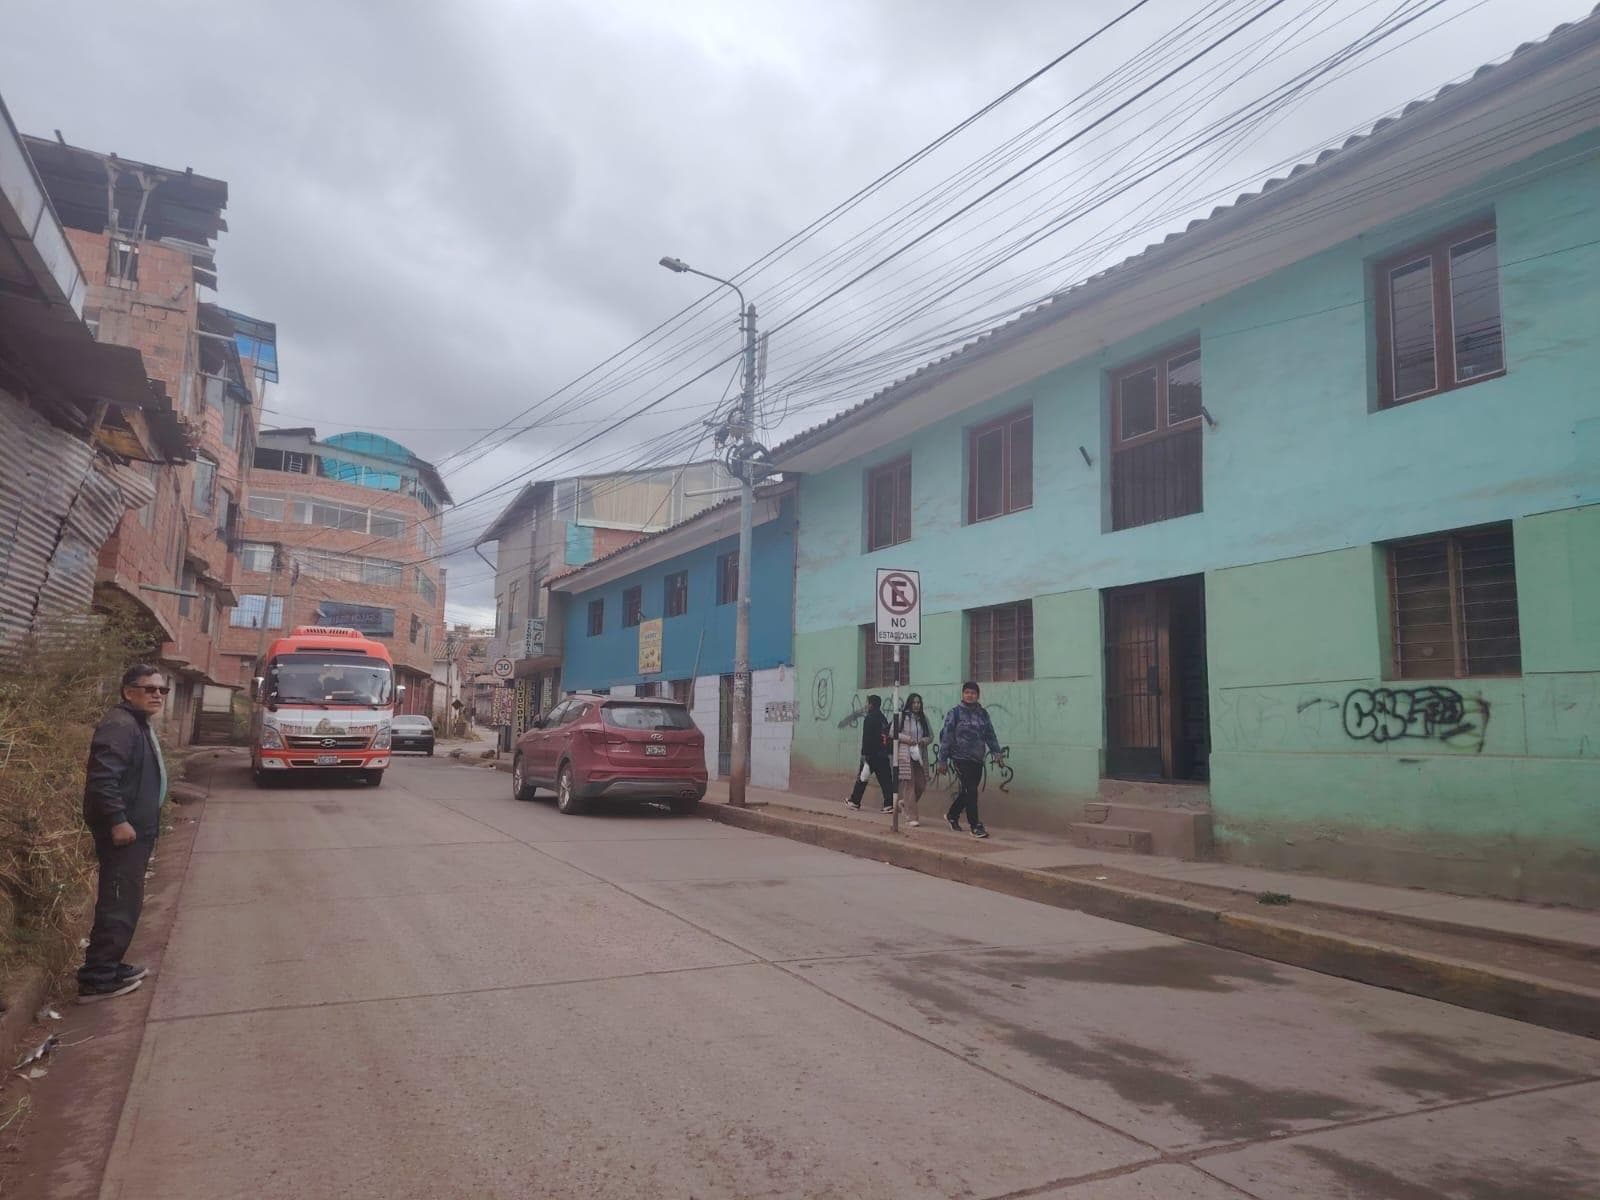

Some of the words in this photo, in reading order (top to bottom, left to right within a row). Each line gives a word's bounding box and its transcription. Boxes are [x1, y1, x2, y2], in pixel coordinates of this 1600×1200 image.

[891, 617, 907, 628] NO
[879, 631, 917, 640] ESTACIONAR
[497, 663, 509, 671] 30
